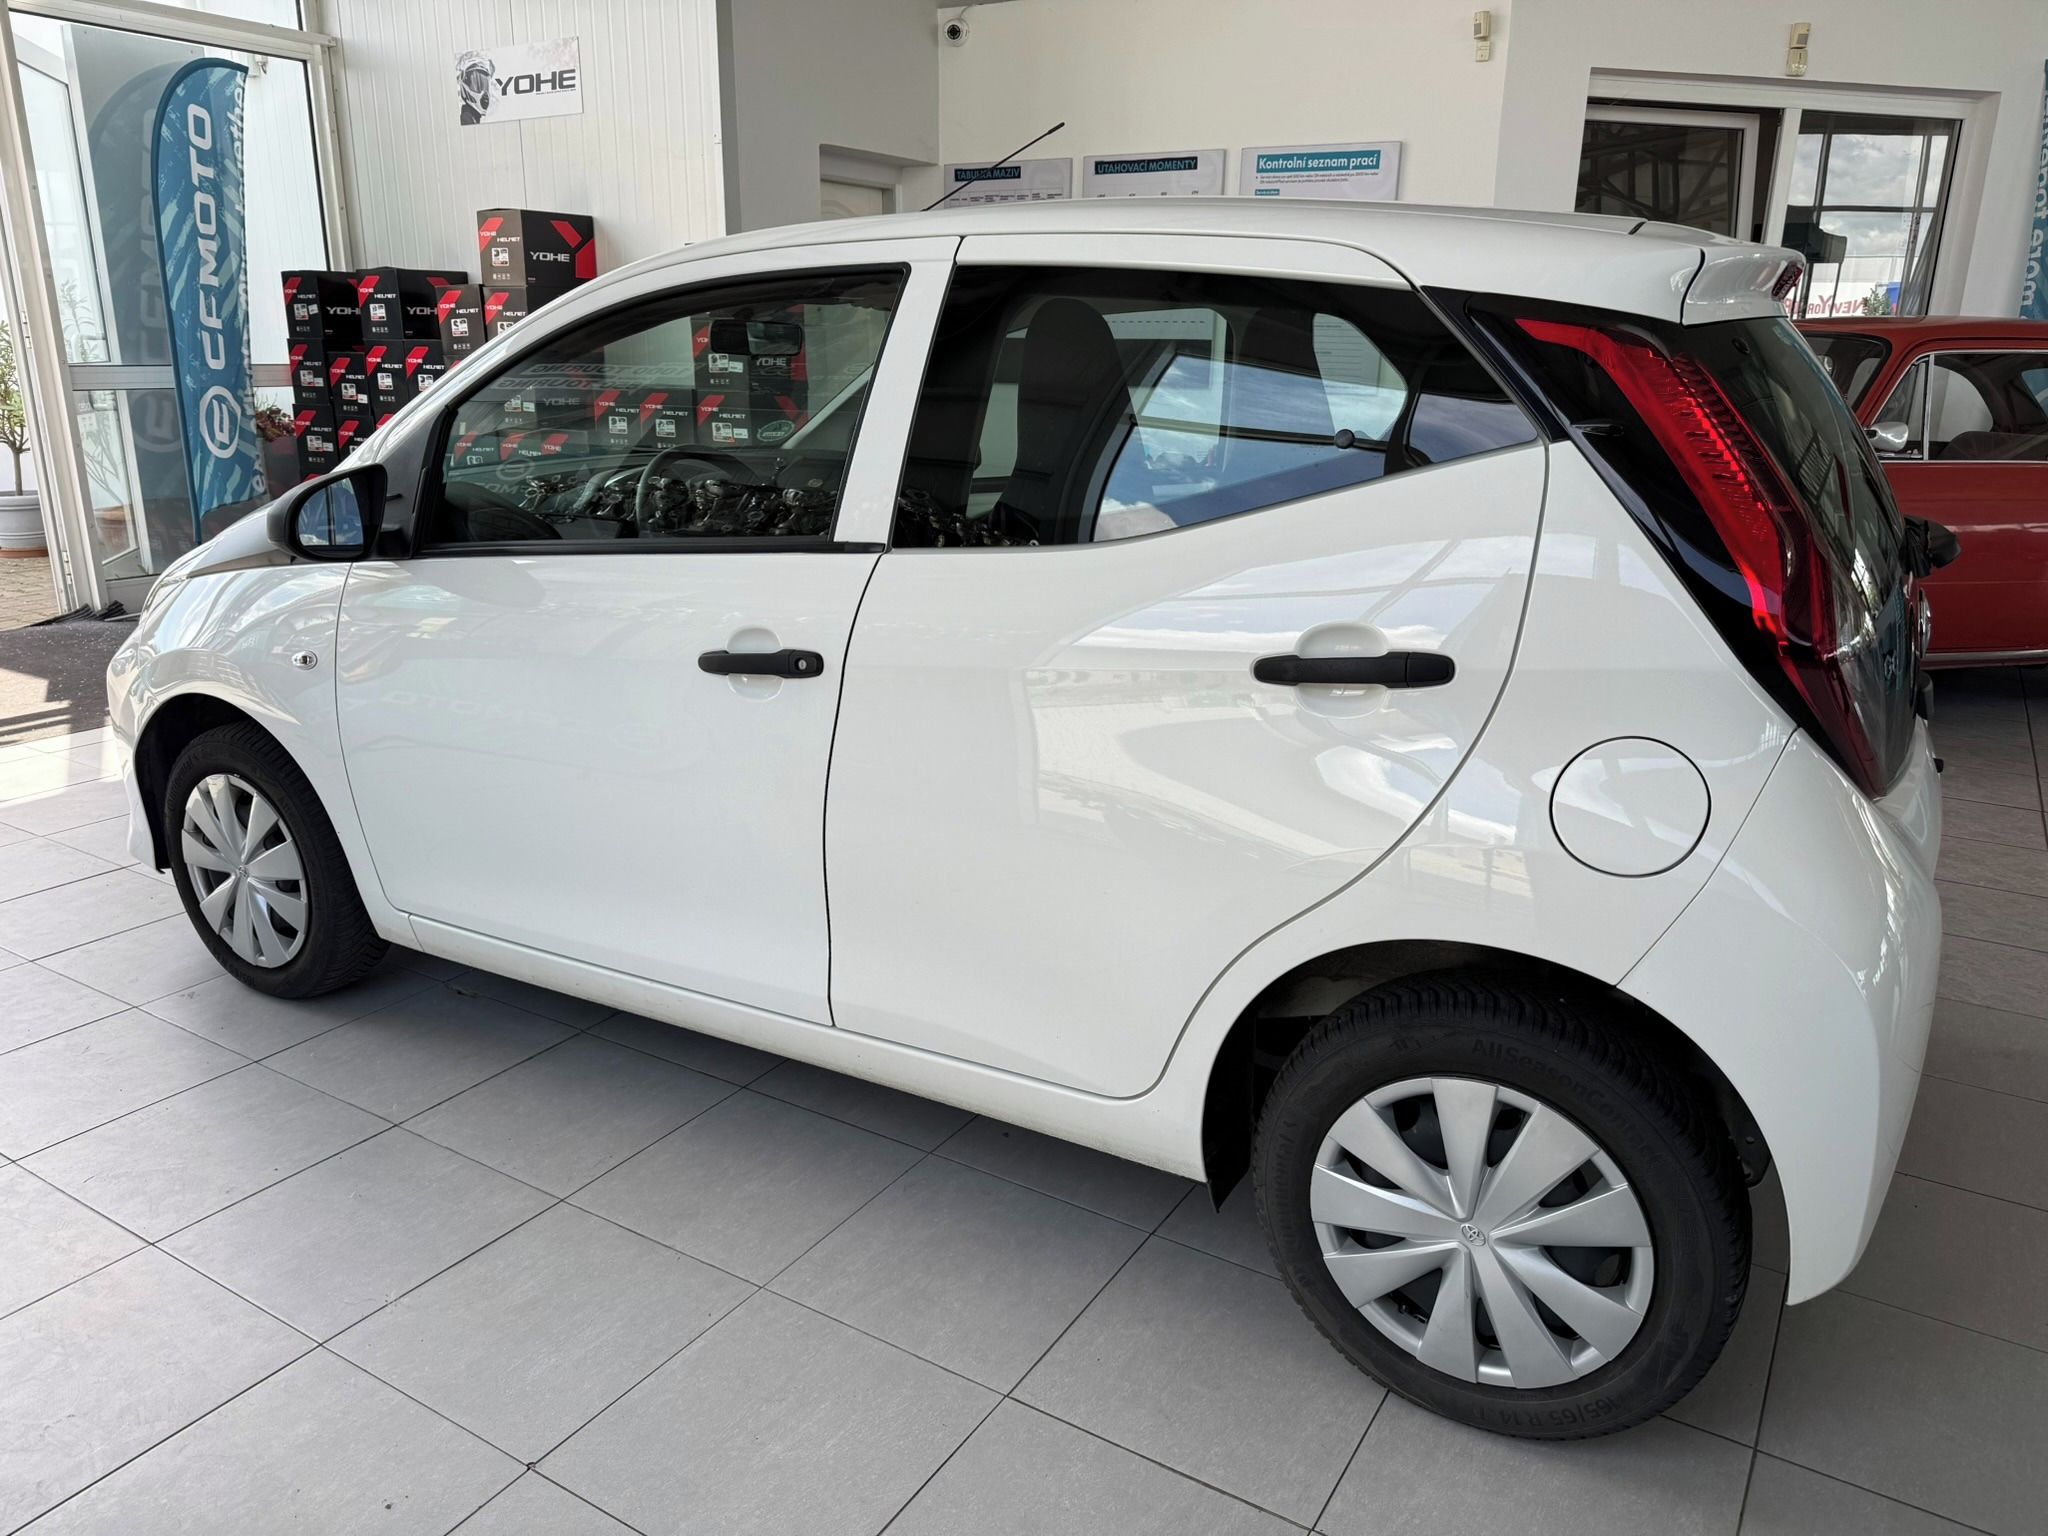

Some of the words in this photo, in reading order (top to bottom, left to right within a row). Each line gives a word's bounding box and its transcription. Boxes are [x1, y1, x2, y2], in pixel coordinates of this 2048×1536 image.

[495, 68, 576, 96] YOHE
[1097, 161, 1148, 174] UTAHOVACÍ
[1149, 159, 1196, 171] MOMENTY
[1259, 156, 1306, 169] Kontrolní
[1308, 158, 1348, 168] seznam
[1350, 154, 1377, 169] prací
[992, 167, 1020, 178] MAZIV
[187, 103, 226, 370] CFMOTO
[529, 251, 570, 262] YOHE
[326, 306, 361, 315] YOH
[406, 306, 438, 315] YOH
[755, 357, 786, 367] YOHE
[543, 397, 581, 406] YOHE
